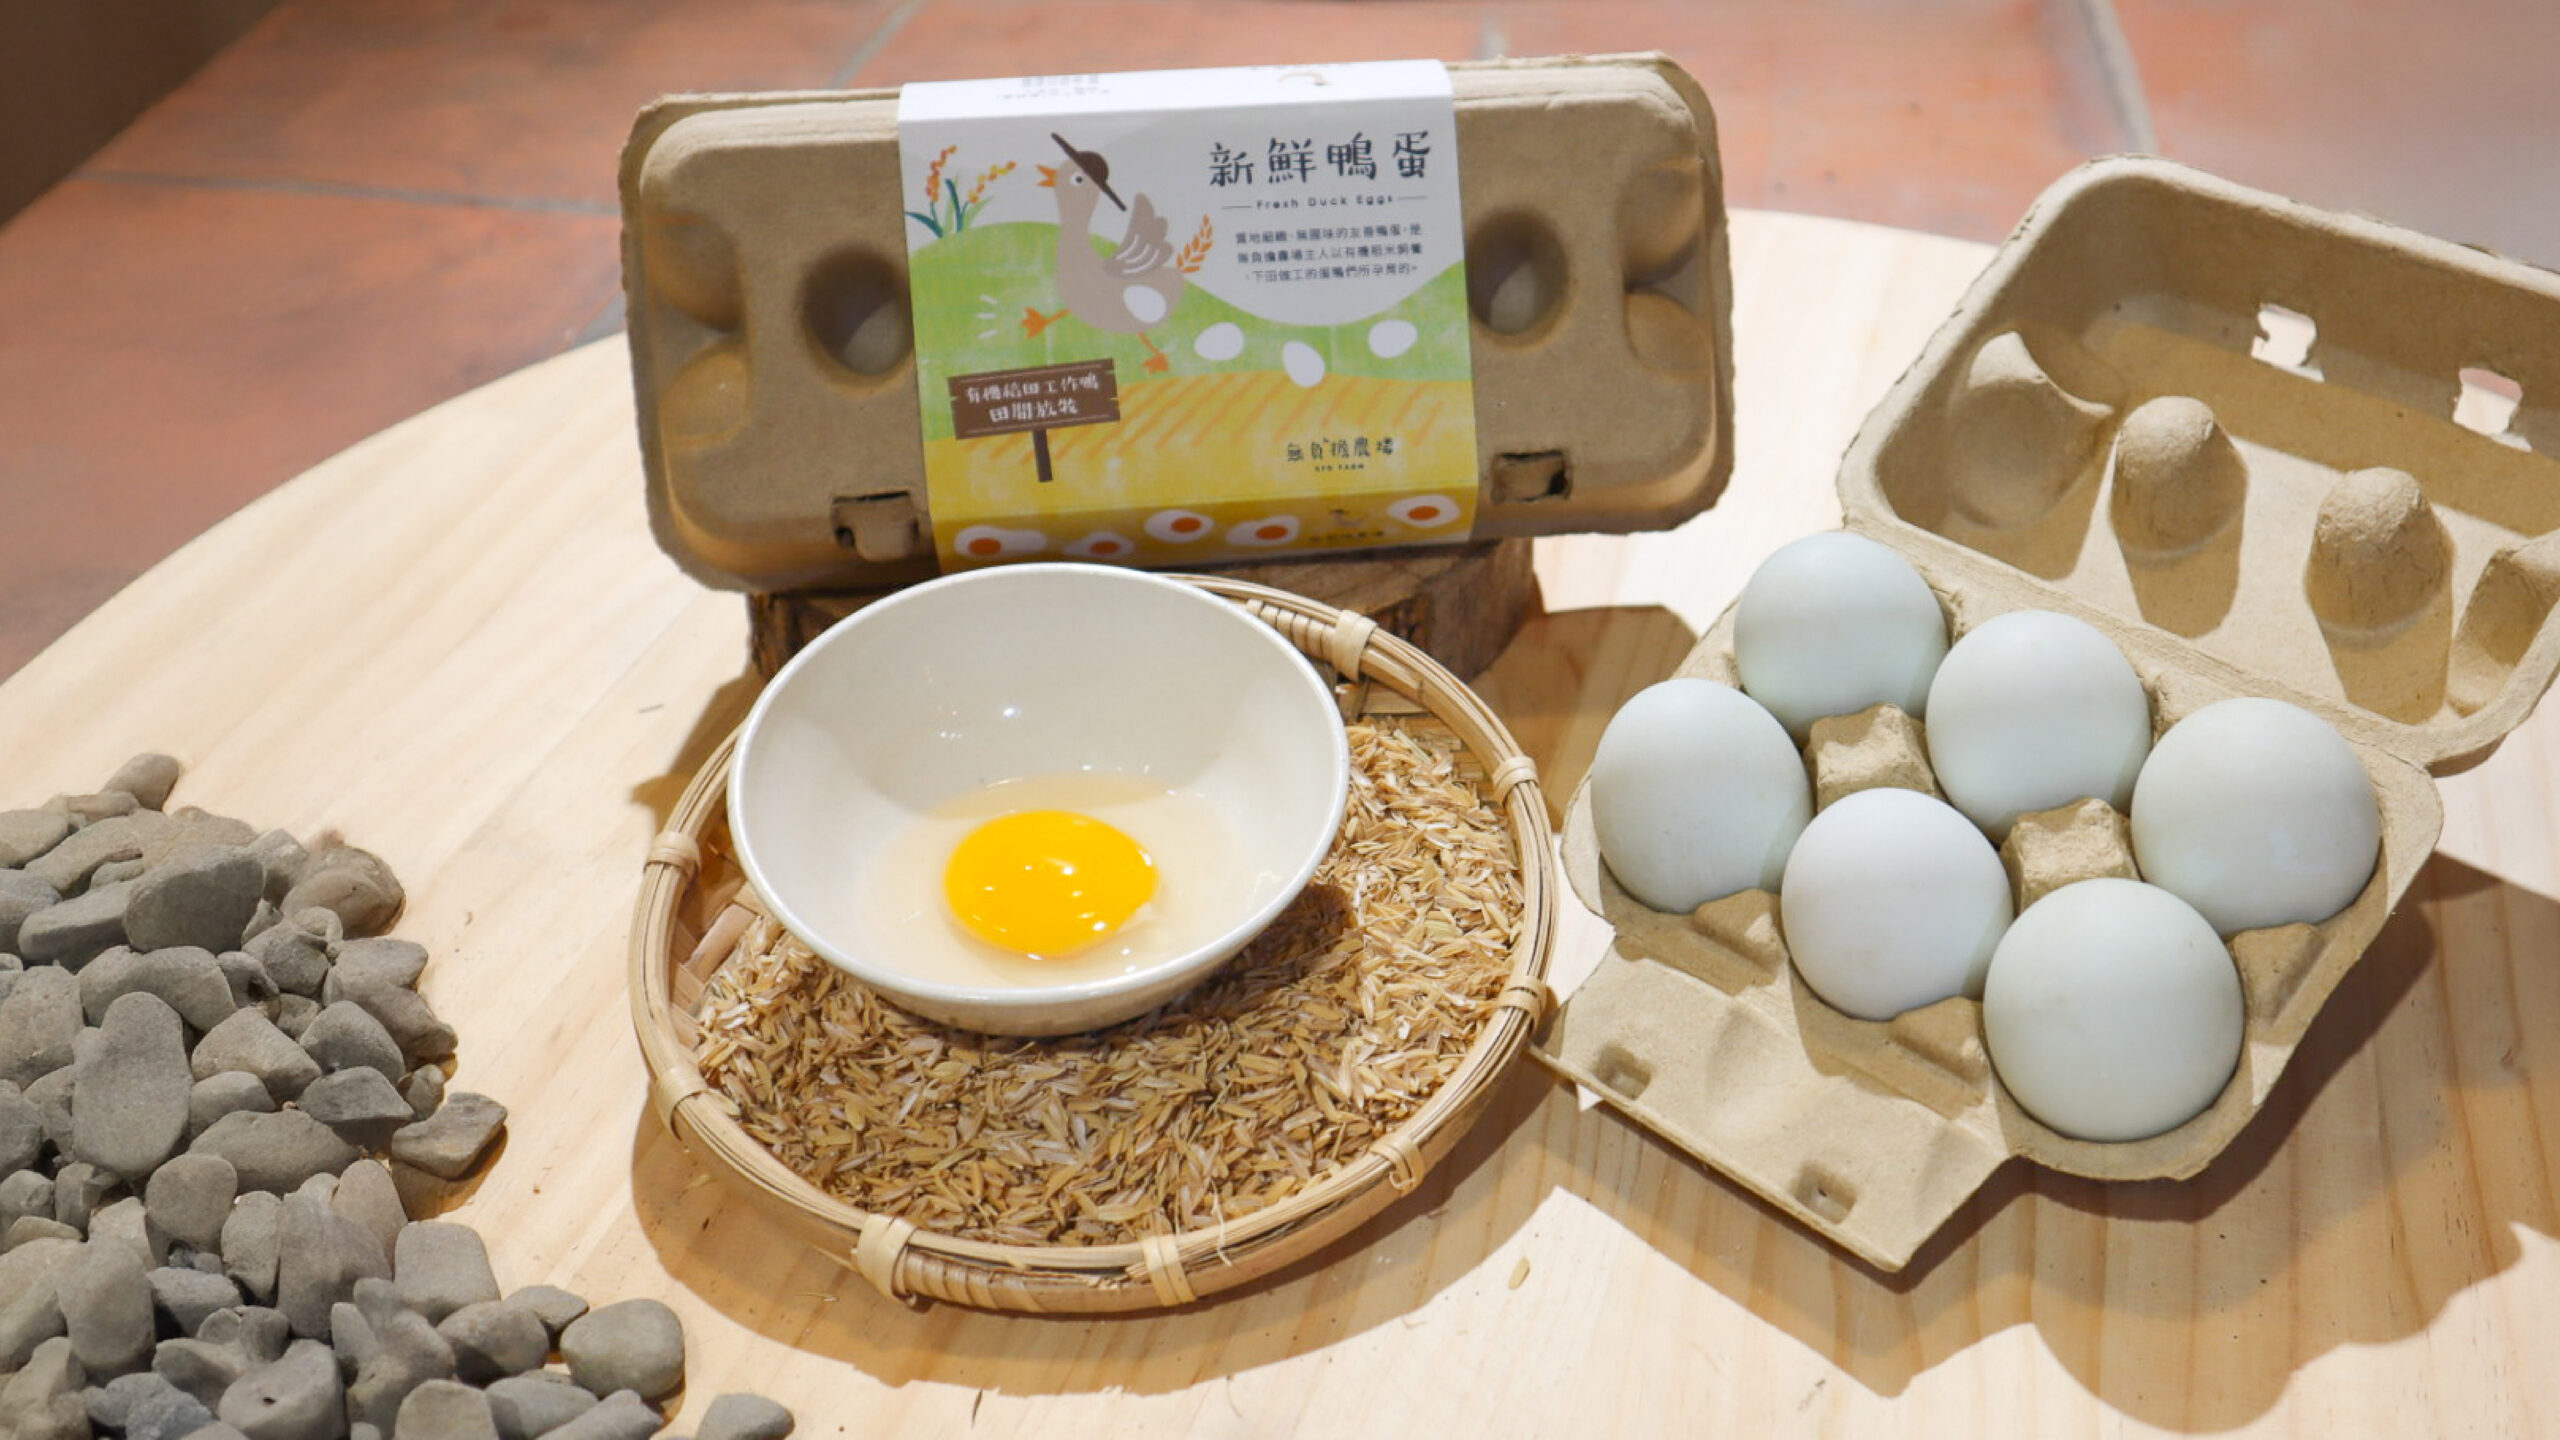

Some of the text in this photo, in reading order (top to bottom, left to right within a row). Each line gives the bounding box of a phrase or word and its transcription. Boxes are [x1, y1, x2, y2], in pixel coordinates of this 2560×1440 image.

[1209, 130, 1431, 187] 新鮮鴨蛋
[1257, 194, 1393, 210] Fresh Duck Eggs
